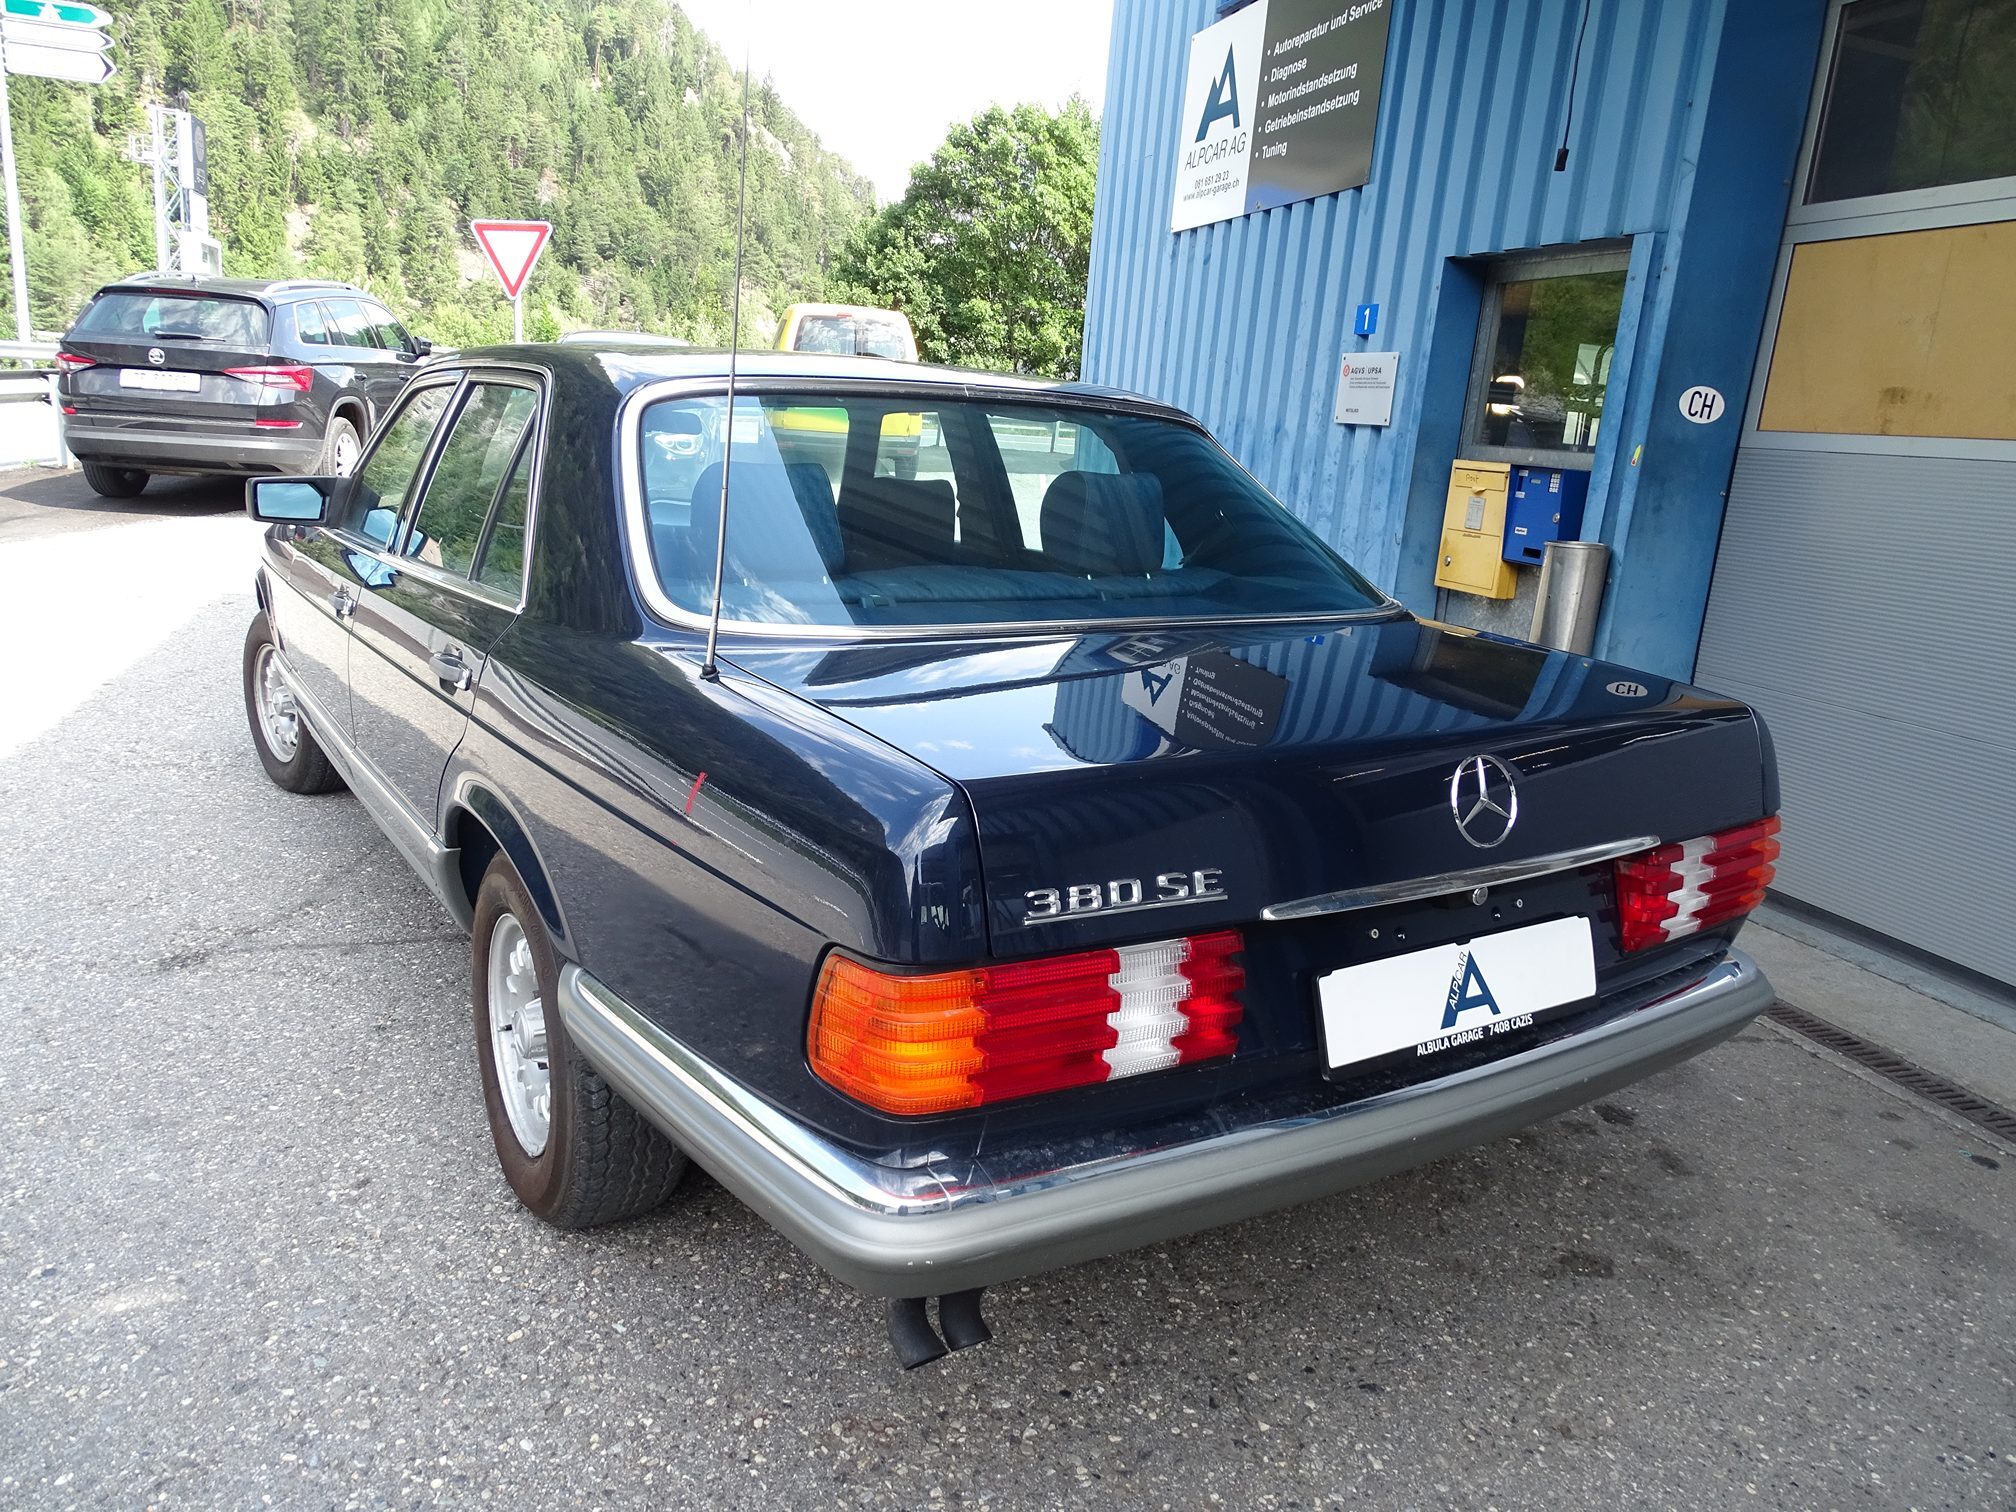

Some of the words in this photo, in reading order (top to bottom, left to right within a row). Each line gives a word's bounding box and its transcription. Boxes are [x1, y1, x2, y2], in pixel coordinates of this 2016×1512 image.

[1273, 20, 1330, 57] Autoreparatur
[1330, 9, 1348, 31] und
[1349, 0, 1383, 22] Service
[1267, 62, 1358, 108] Motorindstandsetzung
[1270, 57, 1308, 83] Diagnose
[1264, 89, 1360, 134] Getriebeinstandsetzung
[1184, 139, 1229, 172] ALPCAR
[1228, 131, 1247, 158] AG
[1262, 141, 1288, 160] Tuning
[1204, 175, 1214, 187] 651
[1215, 172, 1222, 184] 29
[1223, 169, 1230, 182] 23
[1364, 307, 1370, 331] 1
[1367, 366, 1382, 375] UPSA
[1688, 390, 1716, 420] CH
[1024, 878, 1143, 918] 380
[1156, 868, 1224, 900] SE
[1448, 951, 1467, 1010] ALPCAR
[1417, 1037, 1451, 1057] ALBULA
[1451, 1027, 1484, 1047] GARAGE
[1488, 1019, 1510, 1036] 7408
[1510, 1013, 1533, 1030] CAZIS
